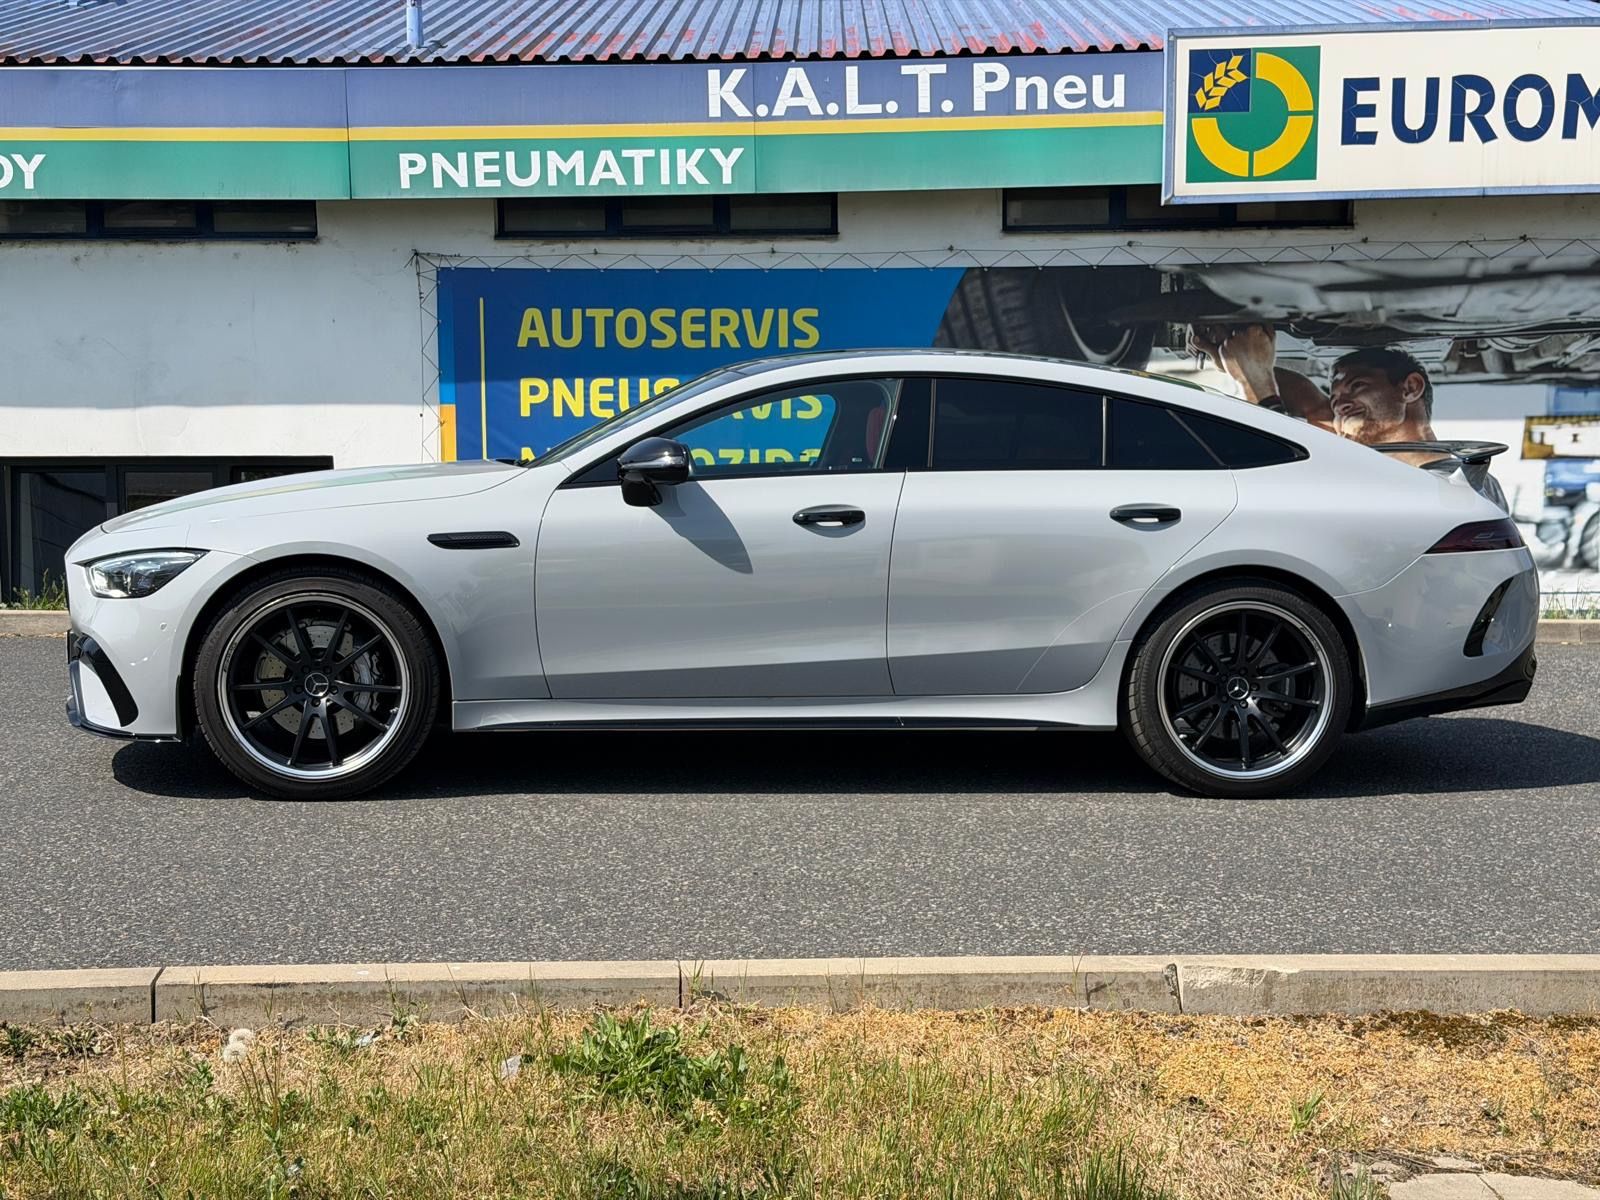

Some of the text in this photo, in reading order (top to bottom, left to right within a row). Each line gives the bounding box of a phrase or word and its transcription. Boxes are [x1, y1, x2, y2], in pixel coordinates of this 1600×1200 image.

[707, 61, 1126, 118] K.A.L.T. Pneu
[1341, 73, 1600, 146] EUROM
[399, 147, 744, 190] PNEUMATIKY
[516, 307, 821, 349] AUTOSERVIS
